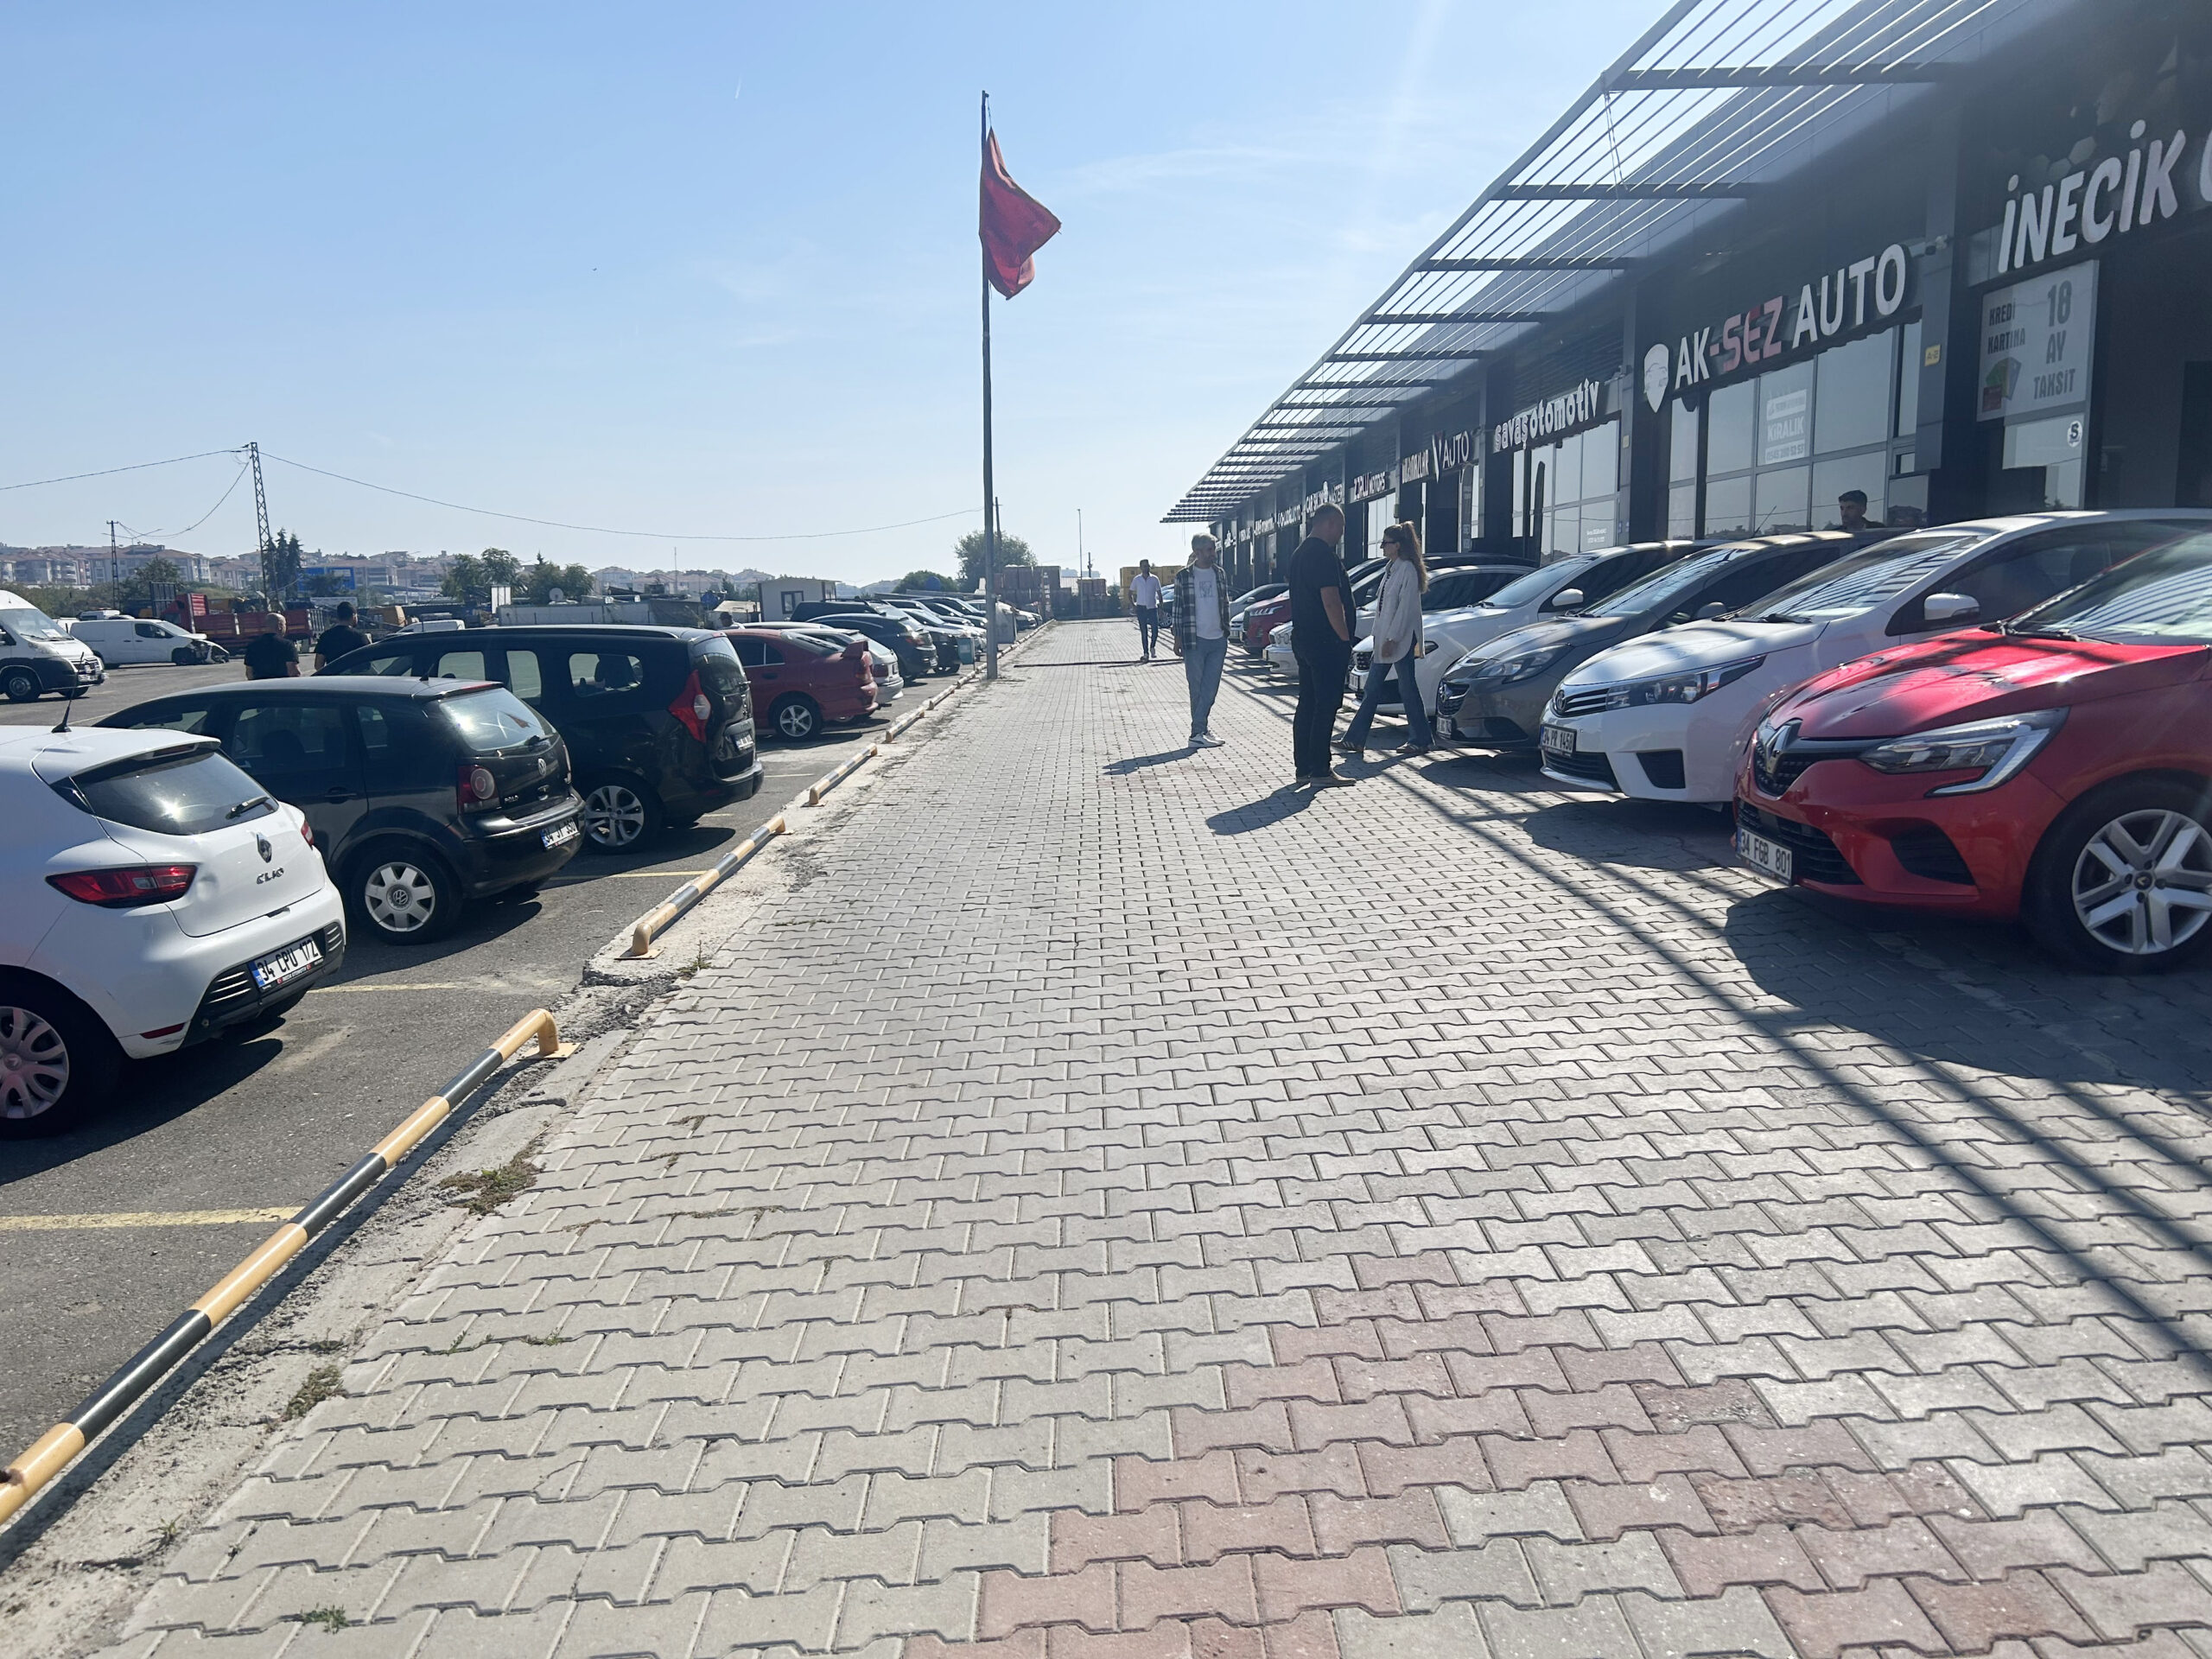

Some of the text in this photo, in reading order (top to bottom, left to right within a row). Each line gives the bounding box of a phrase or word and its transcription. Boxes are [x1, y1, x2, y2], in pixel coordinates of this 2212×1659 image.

[1998, 118, 2186, 274] İNECİK
[1675, 244, 1906, 390] AK-SEZ AUTO
[1989, 297, 2016, 327] KREDİ
[2047, 280, 2073, 327] 18
[1987, 327, 2026, 354] KARTINA
[2046, 330, 2067, 365] AY
[2033, 368, 2076, 399] TAKSİT
[1529, 378, 1599, 439] otomotiv
[1442, 430, 1469, 468] AUTO
[1741, 832, 1751, 855] 34
[1776, 848, 1790, 877] 801
[256, 868, 284, 885] CLIO
[257, 959, 276, 982] 34
[276, 949, 298, 973] CPU
[299, 940, 318, 962] 172
